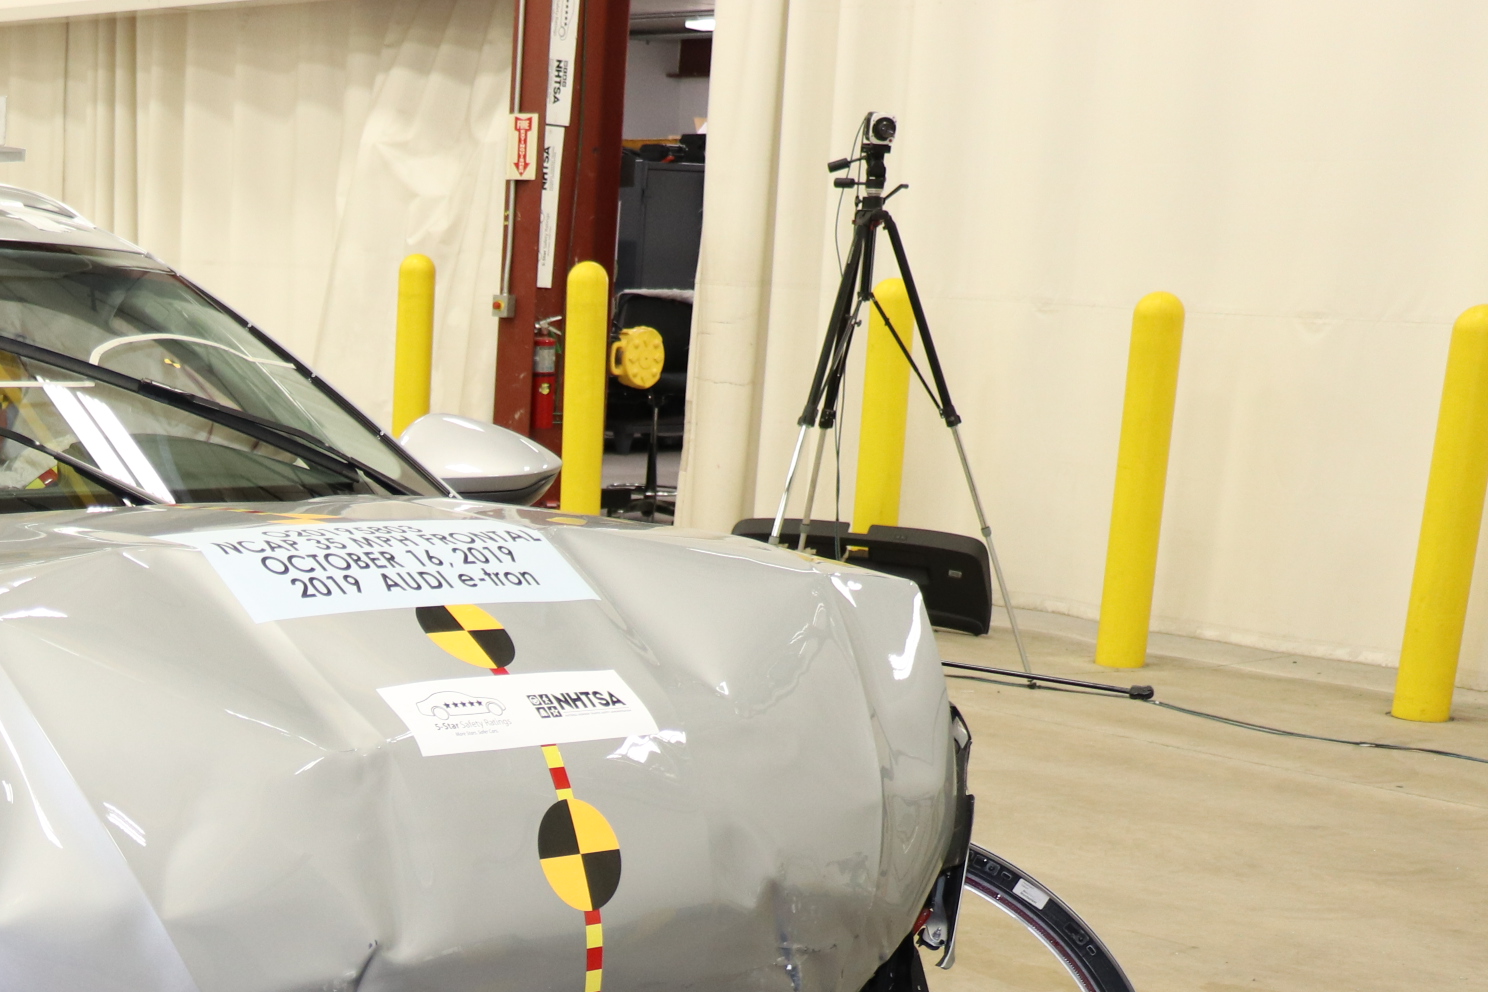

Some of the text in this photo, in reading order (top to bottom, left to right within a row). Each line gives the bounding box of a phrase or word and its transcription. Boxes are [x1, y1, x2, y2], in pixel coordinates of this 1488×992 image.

[552, 59, 563, 104] NHTSA
[211, 529, 543, 555] NCAP 35 MPH FRONTAL
[261, 545, 517, 576] OCTOBER 16, 2019
[291, 567, 541, 599] 2019 AUDI e-tron
[551, 691, 627, 710] NHTSA
[435, 717, 513, 731] 5-Star Safety Ratings
